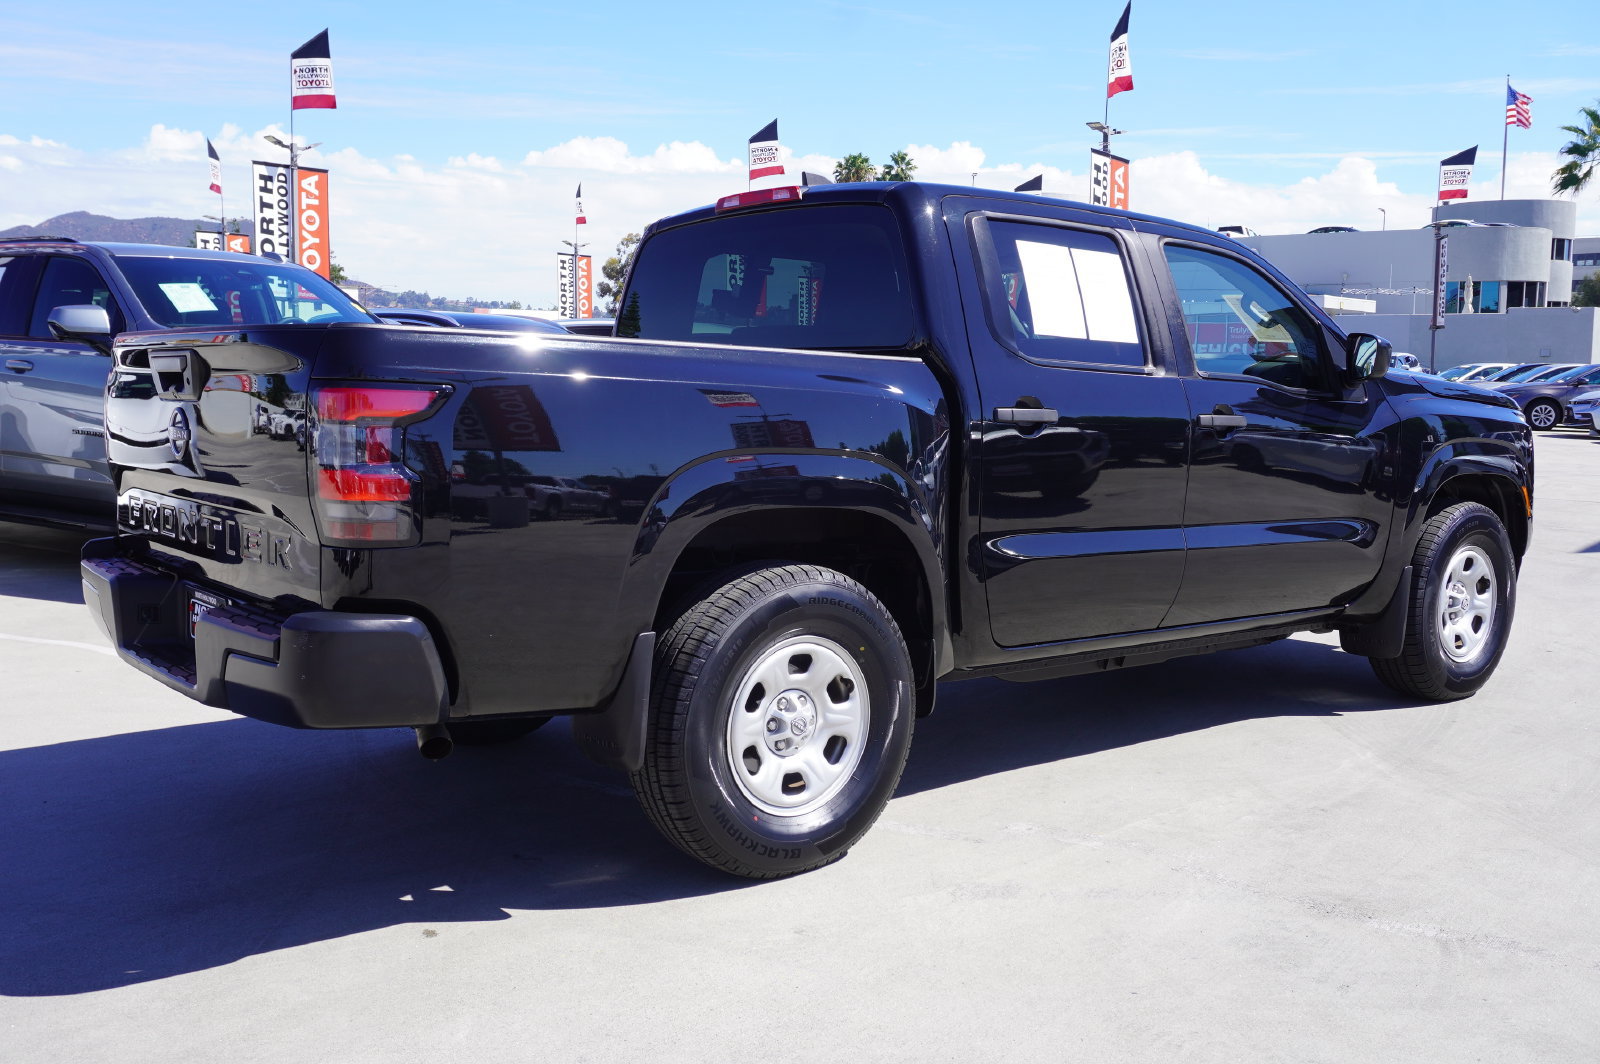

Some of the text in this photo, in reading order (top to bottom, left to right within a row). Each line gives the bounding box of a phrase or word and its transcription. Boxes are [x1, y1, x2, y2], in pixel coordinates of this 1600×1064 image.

[297, 79, 330, 87] TOYOTA
[298, 66, 329, 74] NORTH
[560, 259, 568, 317] NORTH
[578, 258, 589, 318] TOYOTA
[129, 495, 293, 570] FRONTIER
[709, 803, 802, 860] BLACKHAWK
